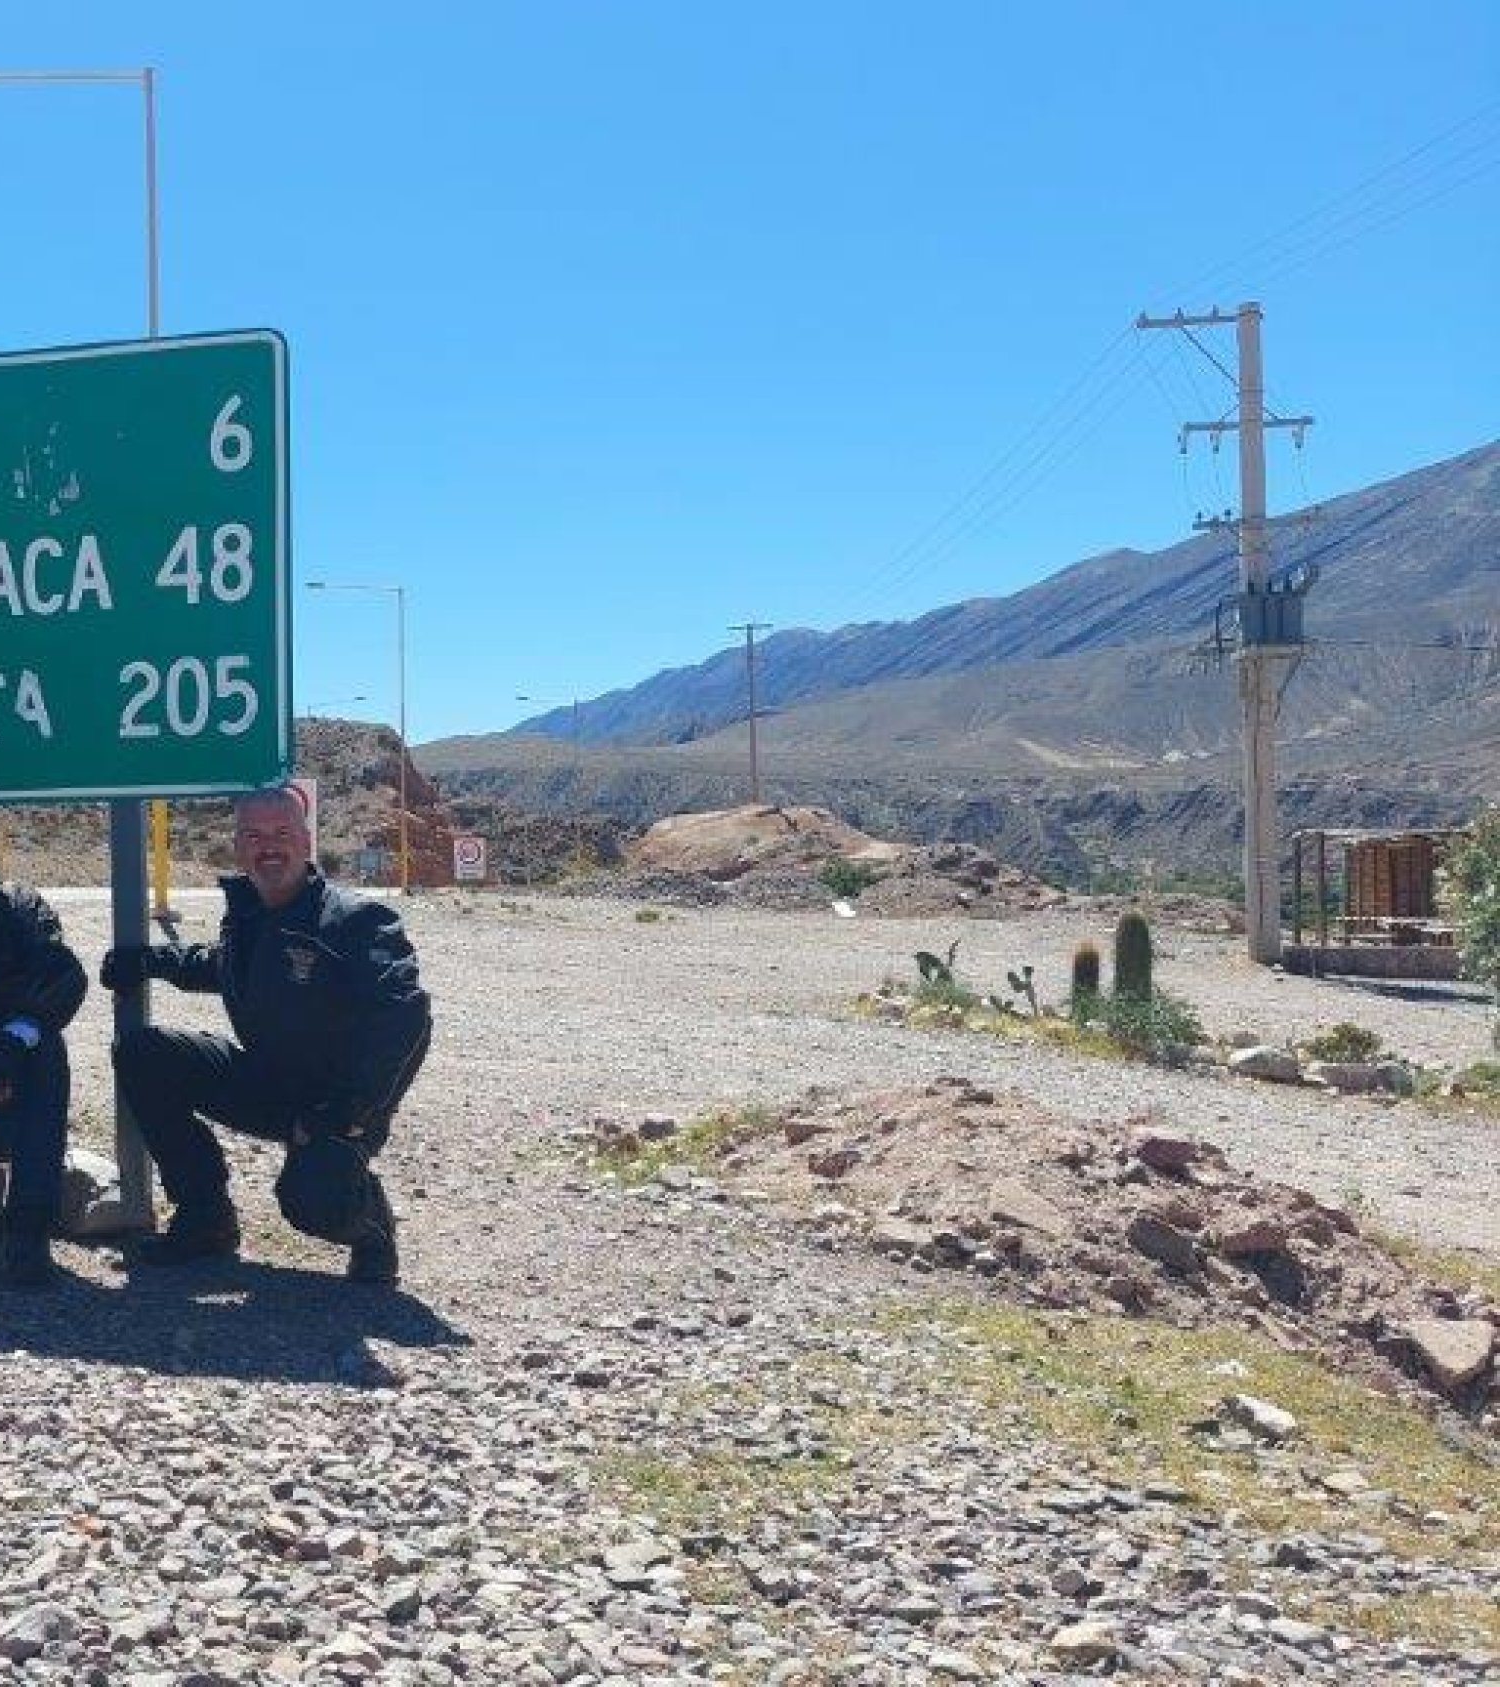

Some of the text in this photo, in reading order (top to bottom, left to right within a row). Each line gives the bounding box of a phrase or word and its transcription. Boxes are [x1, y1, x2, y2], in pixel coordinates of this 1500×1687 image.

[210, 395, 253, 472] 6
[155, 523, 253, 604] 48
[119, 655, 259, 739] 205
